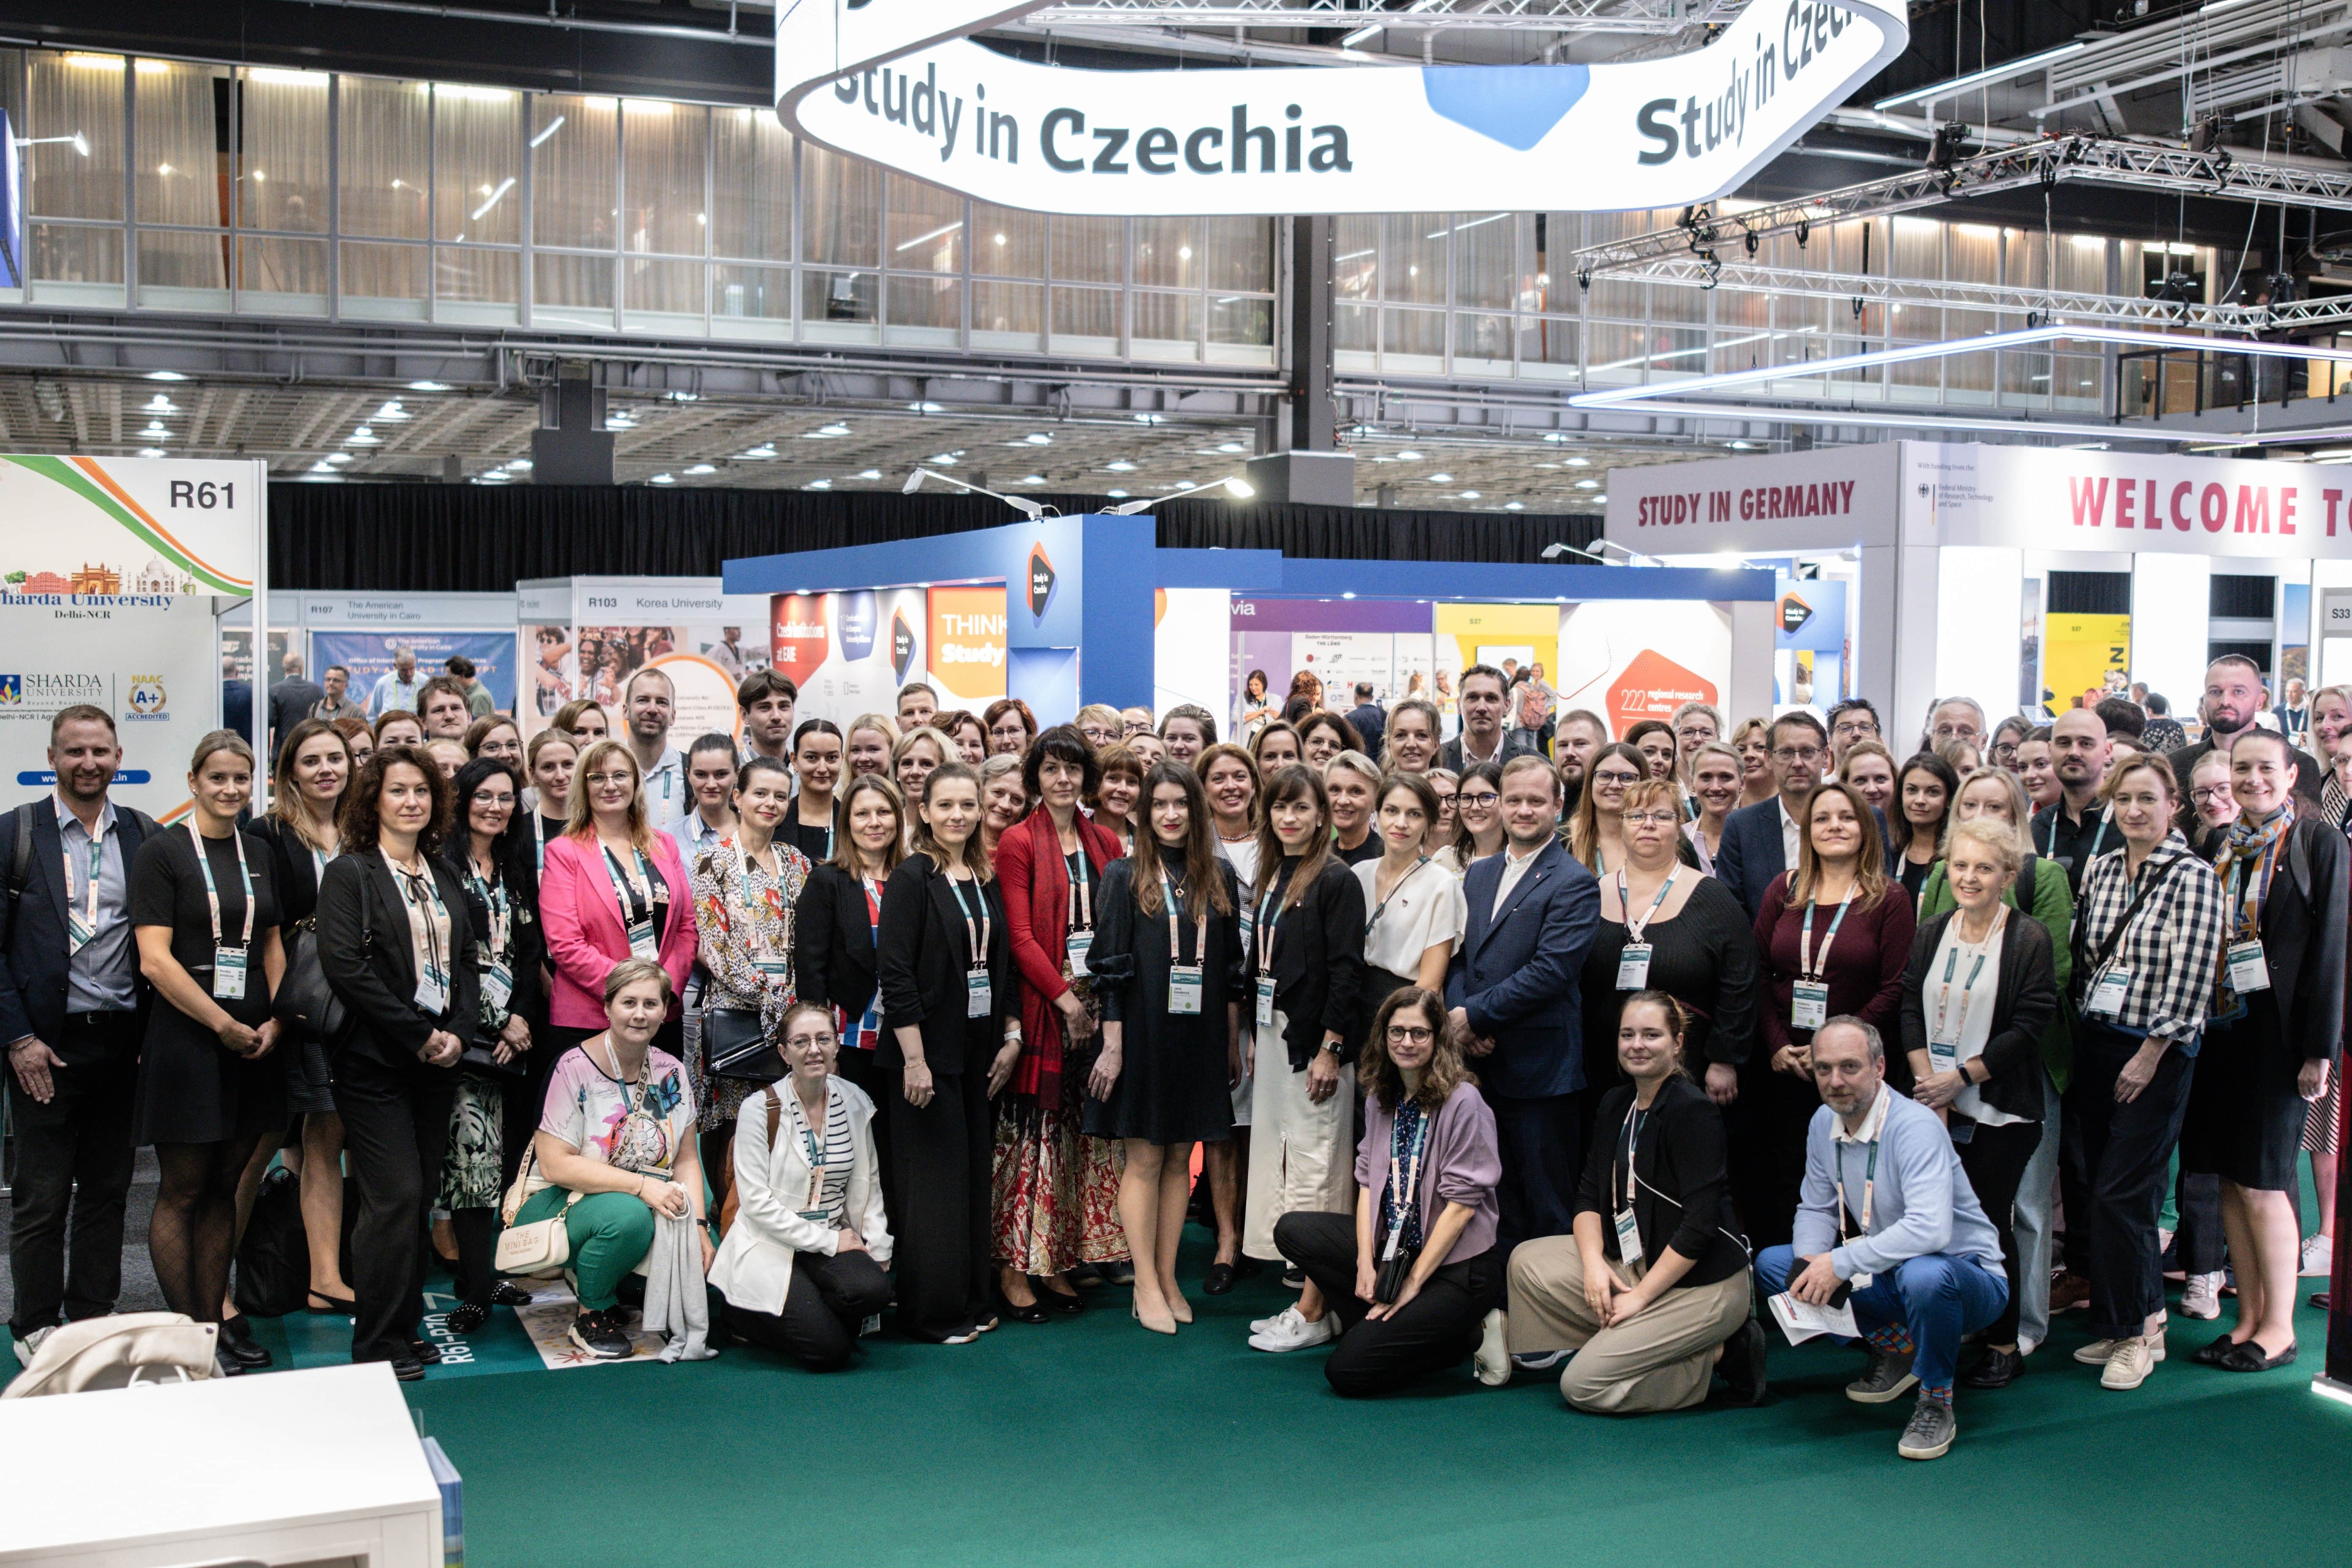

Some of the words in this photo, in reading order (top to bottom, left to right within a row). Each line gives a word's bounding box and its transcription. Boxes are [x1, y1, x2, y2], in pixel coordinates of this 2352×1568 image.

[1636, 57, 1749, 166] Study
[1756, 32, 1775, 111] in
[977, 83, 1018, 165] in
[1040, 103, 1353, 175] Czechia
[1931, 463, 1951, 471] funding
[170, 480, 234, 509] R61
[1967, 494, 1994, 502] Technology
[1638, 491, 1701, 528] STUDY
[1709, 490, 1730, 523] IN
[1739, 480, 1855, 522] GERMANY
[2069, 476, 2298, 535] WELCOME
[2323, 489, 2352, 537] T
[0, 594, 62, 606] harda
[72, 594, 174, 611] University
[365, 601, 403, 609] American
[588, 598, 617, 607] R103
[637, 598, 668, 608] Korea
[672, 598, 723, 610] University
[55, 610, 111, 619] Delhi-NCR
[348, 612, 387, 621] University
[2332, 608, 2350, 619] S33
[777, 621, 792, 638] Czech
[941, 642, 1005, 667] Study
[26, 674, 103, 688] SHARDA
[131, 675, 163, 684] NAAC
[26, 688, 103, 697] UNIVERSITY
[136, 691, 159, 704] A+
[1647, 688, 1674, 701] regional
[1675, 690, 1704, 700] research
[1621, 689, 1645, 711] 222
[1647, 703, 1672, 713] centres
[516, 1230, 530, 1240] THE
[505, 1241, 521, 1251] MINI
[523, 1237, 539, 1247] BAG
